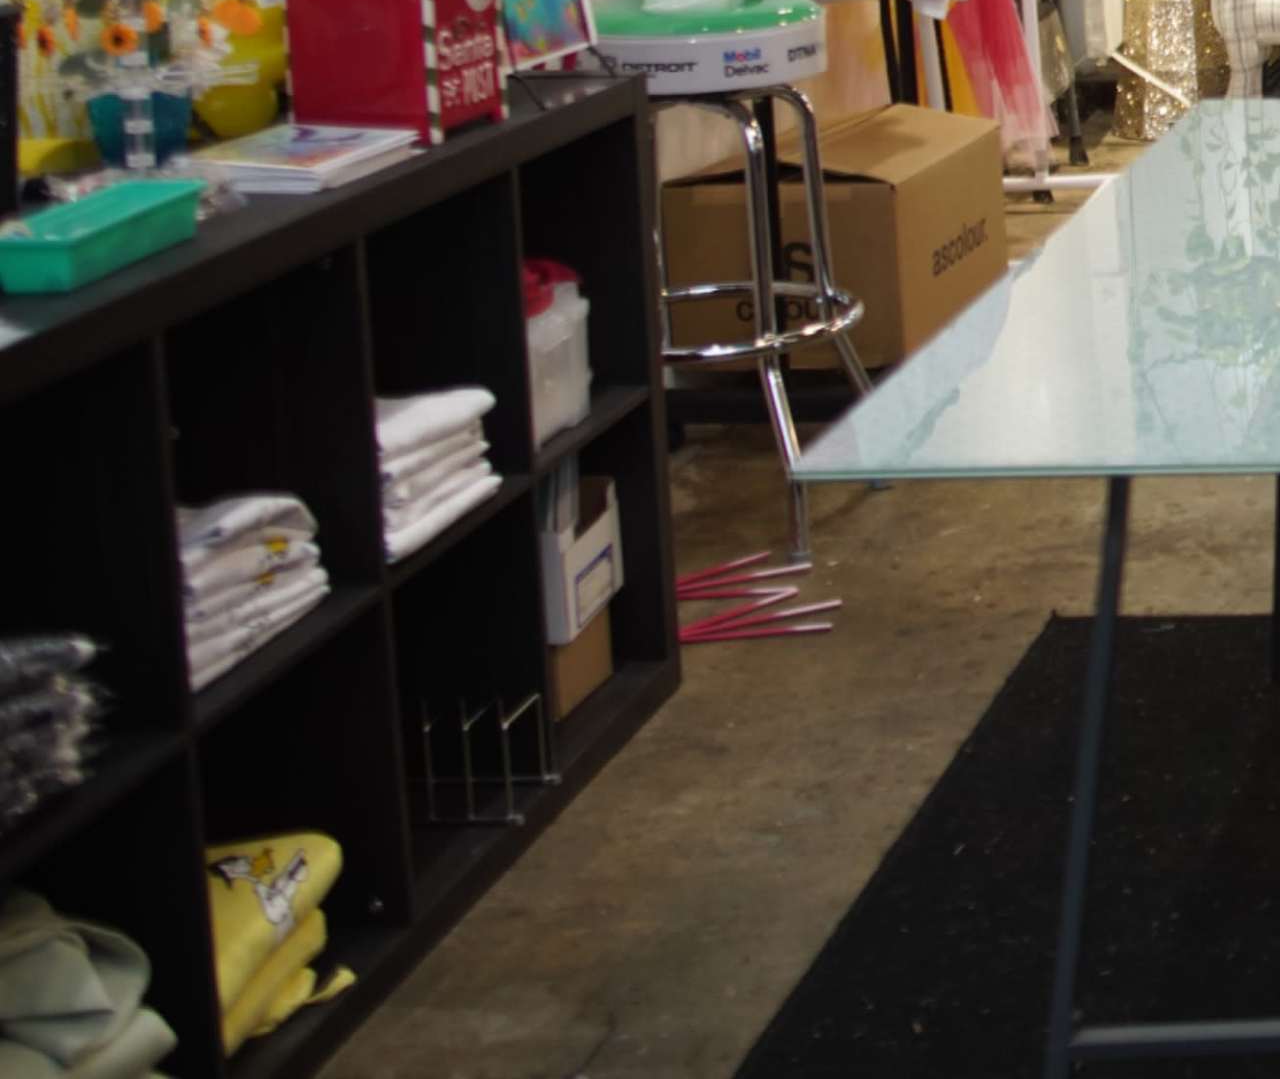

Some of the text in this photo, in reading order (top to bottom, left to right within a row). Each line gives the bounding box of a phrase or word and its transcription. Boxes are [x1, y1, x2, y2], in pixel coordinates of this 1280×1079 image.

[722, 47, 762, 63] Mobil
[724, 64, 770, 79] Delvac
[932, 218, 989, 278] ascolour
